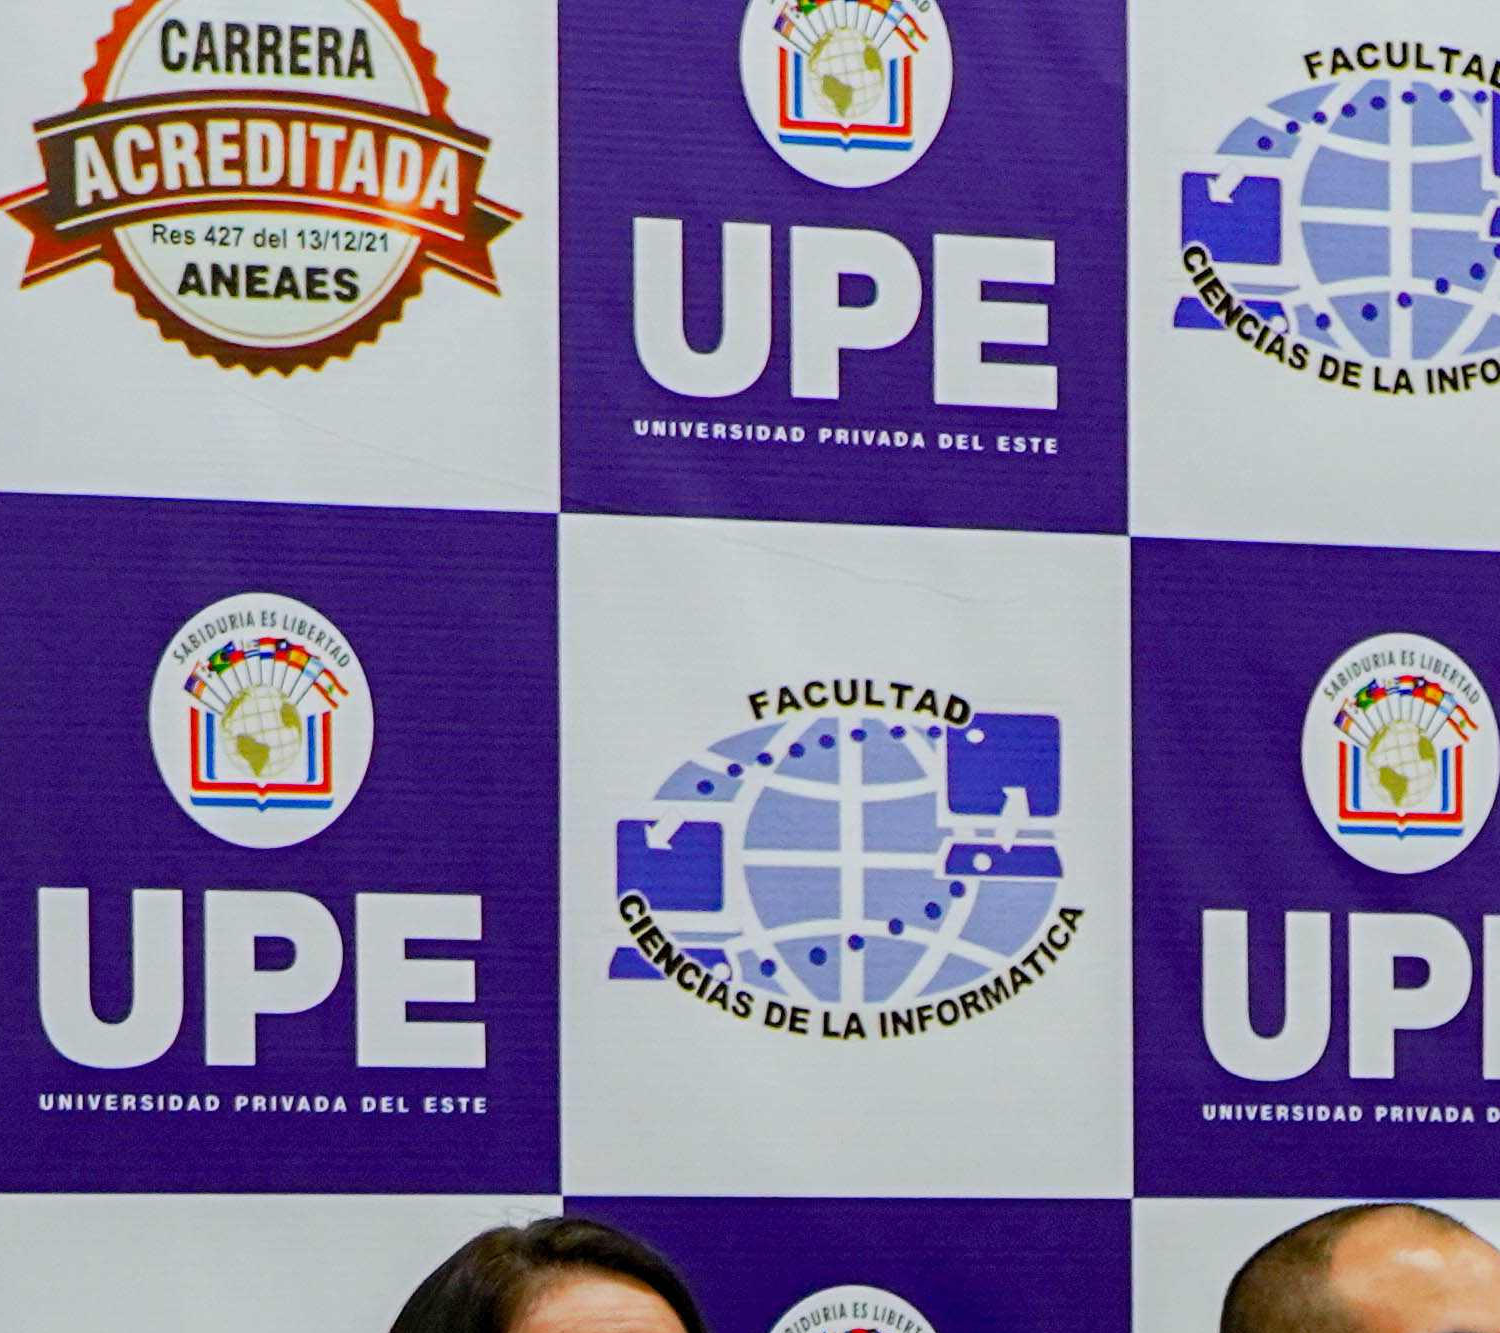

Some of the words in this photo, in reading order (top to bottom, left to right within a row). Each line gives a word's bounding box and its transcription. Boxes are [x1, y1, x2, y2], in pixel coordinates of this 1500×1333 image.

[160, 19, 375, 79] CARRERA
[73, 119, 460, 216] ACREDITADA
[152, 223, 195, 246] Res
[204, 225, 244, 247] 427
[253, 228, 287, 249] del
[296, 230, 389, 253] 13/12/21
[177, 262, 360, 303] ANEAES
[633, 216, 1058, 410] UPE
[1182, 244, 1308, 370] CIENCIAS
[1318, 354, 1362, 389] DE
[1373, 368, 1415, 395] LA
[633, 419, 805, 442] UNIVERSIDAD
[819, 427, 925, 448] PRIVADA
[938, 433, 985, 451] DEL
[997, 435, 1058, 454] ESTE
[172, 610, 256, 665] SABIDURIA
[260, 609, 278, 627] ES
[282, 613, 352, 669] LIBERTAD
[748, 678, 972, 727] FACULTAD
[1323, 650, 1396, 702] SABIDURIA
[1400, 649, 1416, 666] ES
[1420, 653, 1481, 706] LIBERTAD
[38, 887, 486, 1069] UPE
[618, 894, 754, 1019] CIENCIAS
[763, 1001, 810, 1036] DE
[822, 1012, 866, 1039] LA
[879, 904, 1085, 1039] INFORMATICA
[39, 1093, 221, 1112] UNIVERSIDAD
[234, 1095, 347, 1113] PRIVADA
[361, 1096, 409, 1114] DEL
[424, 1097, 488, 1115] ESTE
[1202, 1104, 1363, 1123] UNIVERSIDAD
[1375, 1105, 1475, 1124] PRIVADA
[852, 1302, 868, 1318] ES
